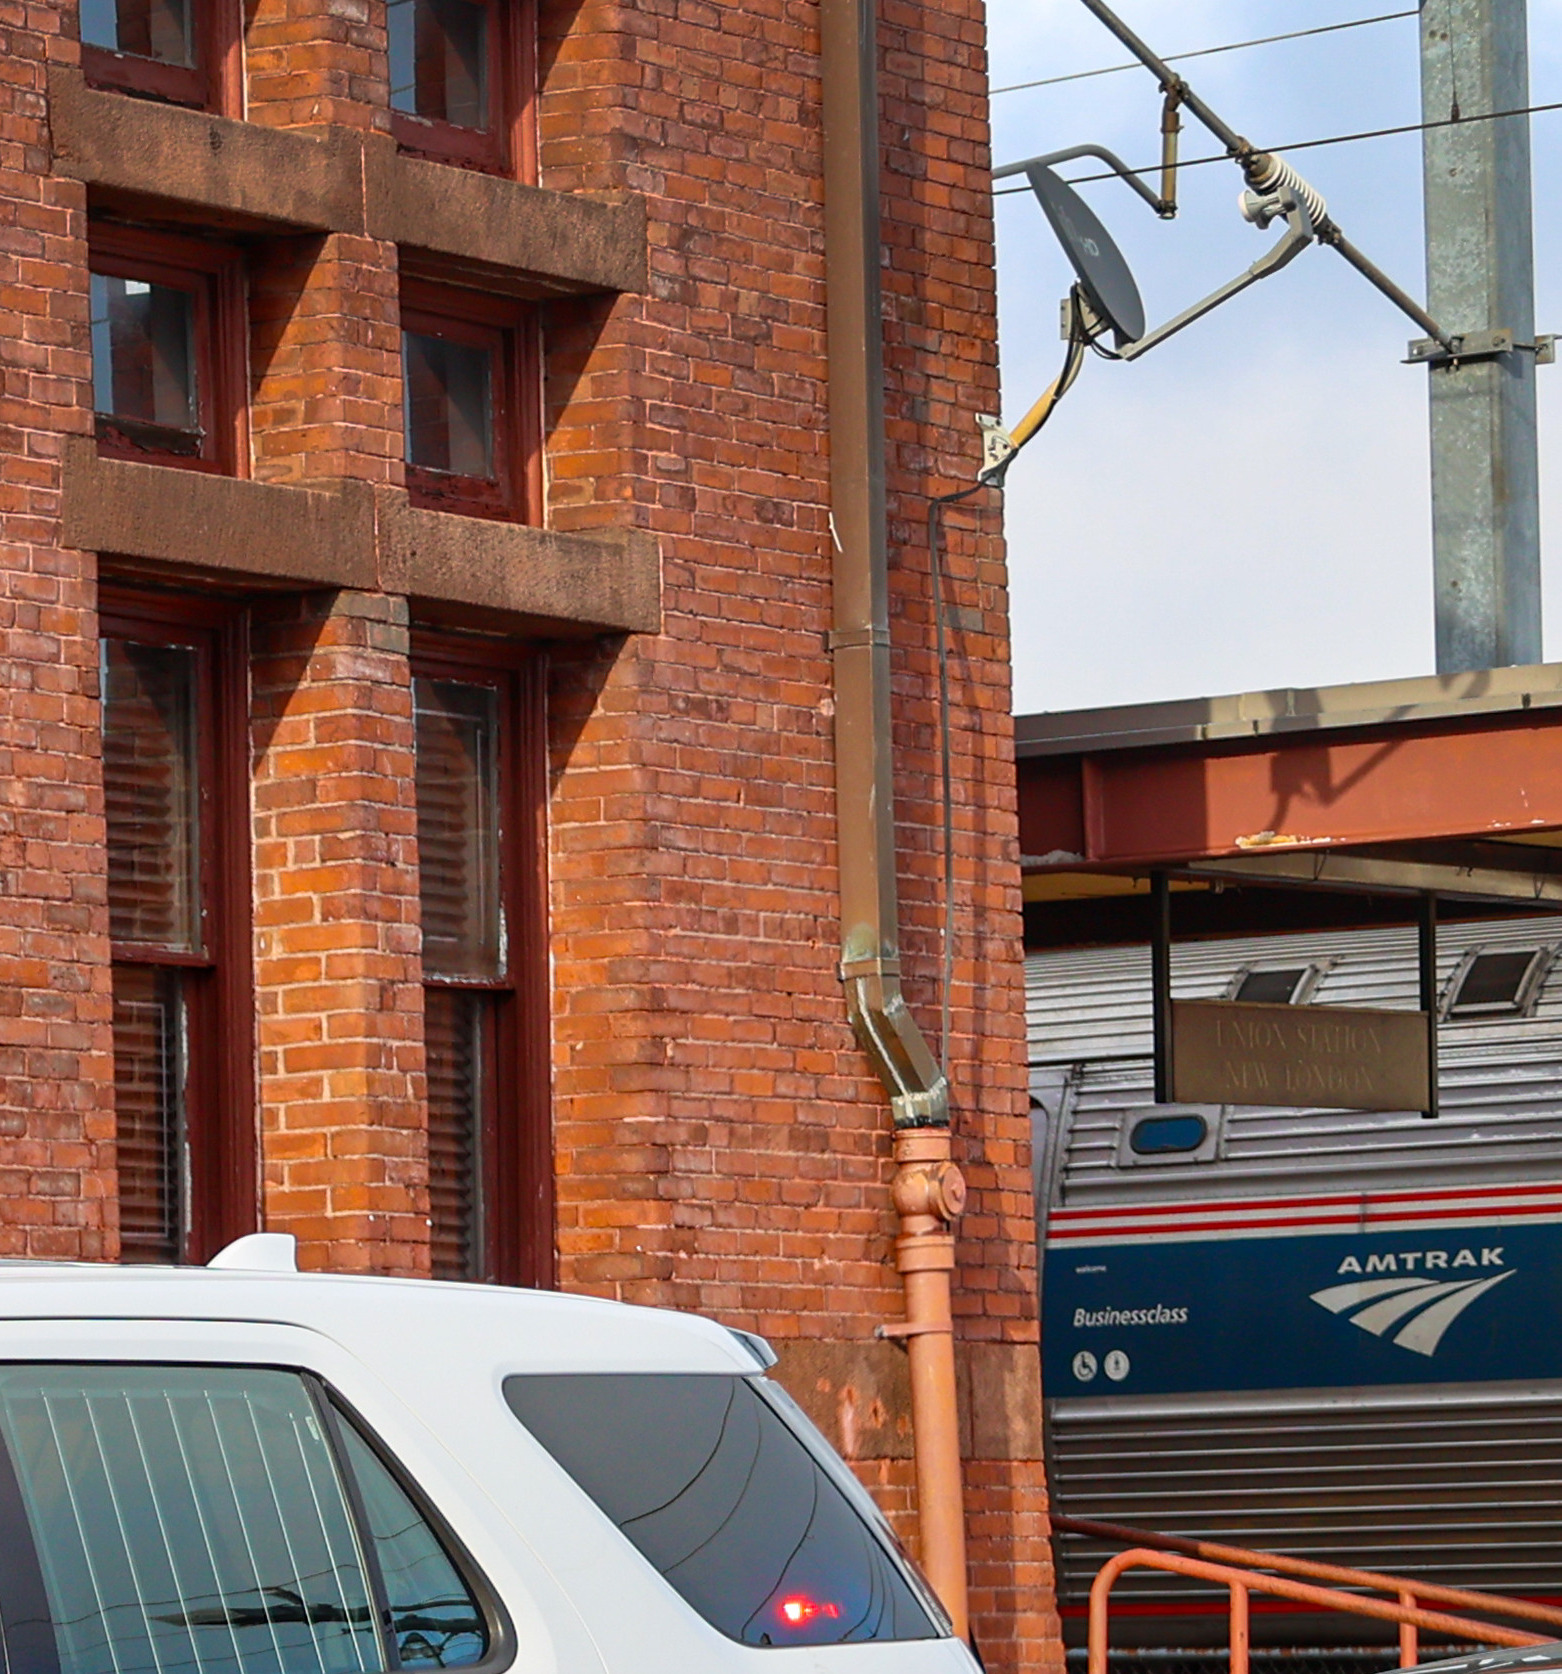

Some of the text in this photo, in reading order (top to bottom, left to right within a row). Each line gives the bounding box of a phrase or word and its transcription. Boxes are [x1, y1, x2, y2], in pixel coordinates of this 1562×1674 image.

[1297, 1024, 1382, 1054] STATION
[1285, 1063, 1375, 1092] LONDON
[1336, 1247, 1505, 1275] AMTRAK
[1073, 1303, 1189, 1328] Businessclass
